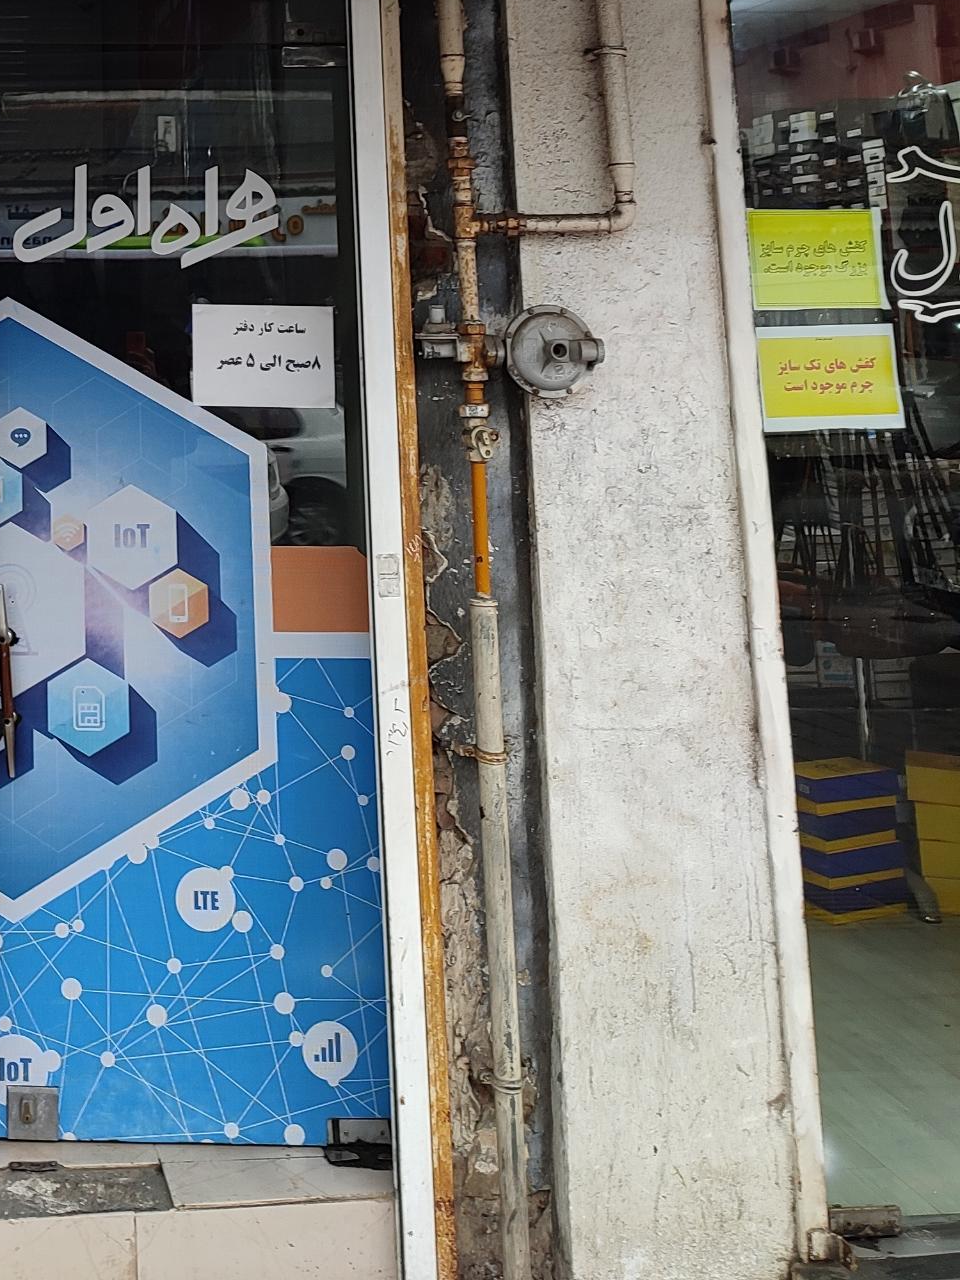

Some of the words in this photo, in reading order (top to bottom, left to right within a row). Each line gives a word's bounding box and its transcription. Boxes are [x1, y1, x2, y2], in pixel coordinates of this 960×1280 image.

[12, 163, 150, 263] اول
[759, 240, 784, 258] سایز
[813, 239, 837, 258] های
[839, 239, 868, 257] کفش
[795, 262, 832, 277] موجود
[233, 320, 255, 336] دفتر
[258, 322, 274, 336] کار
[277, 322, 306, 334] ساعت
[216, 355, 243, 370] عصر
[259, 354, 282, 371] الی
[777, 359, 800, 375] سایز
[803, 358, 821, 371] تک
[824, 358, 847, 374] های
[849, 357, 877, 373] کفش
[783, 379, 808, 392] است
[810, 380, 847, 395] موجود
[113, 523, 151, 549] IoT
[193, 890, 219, 911] LTE
